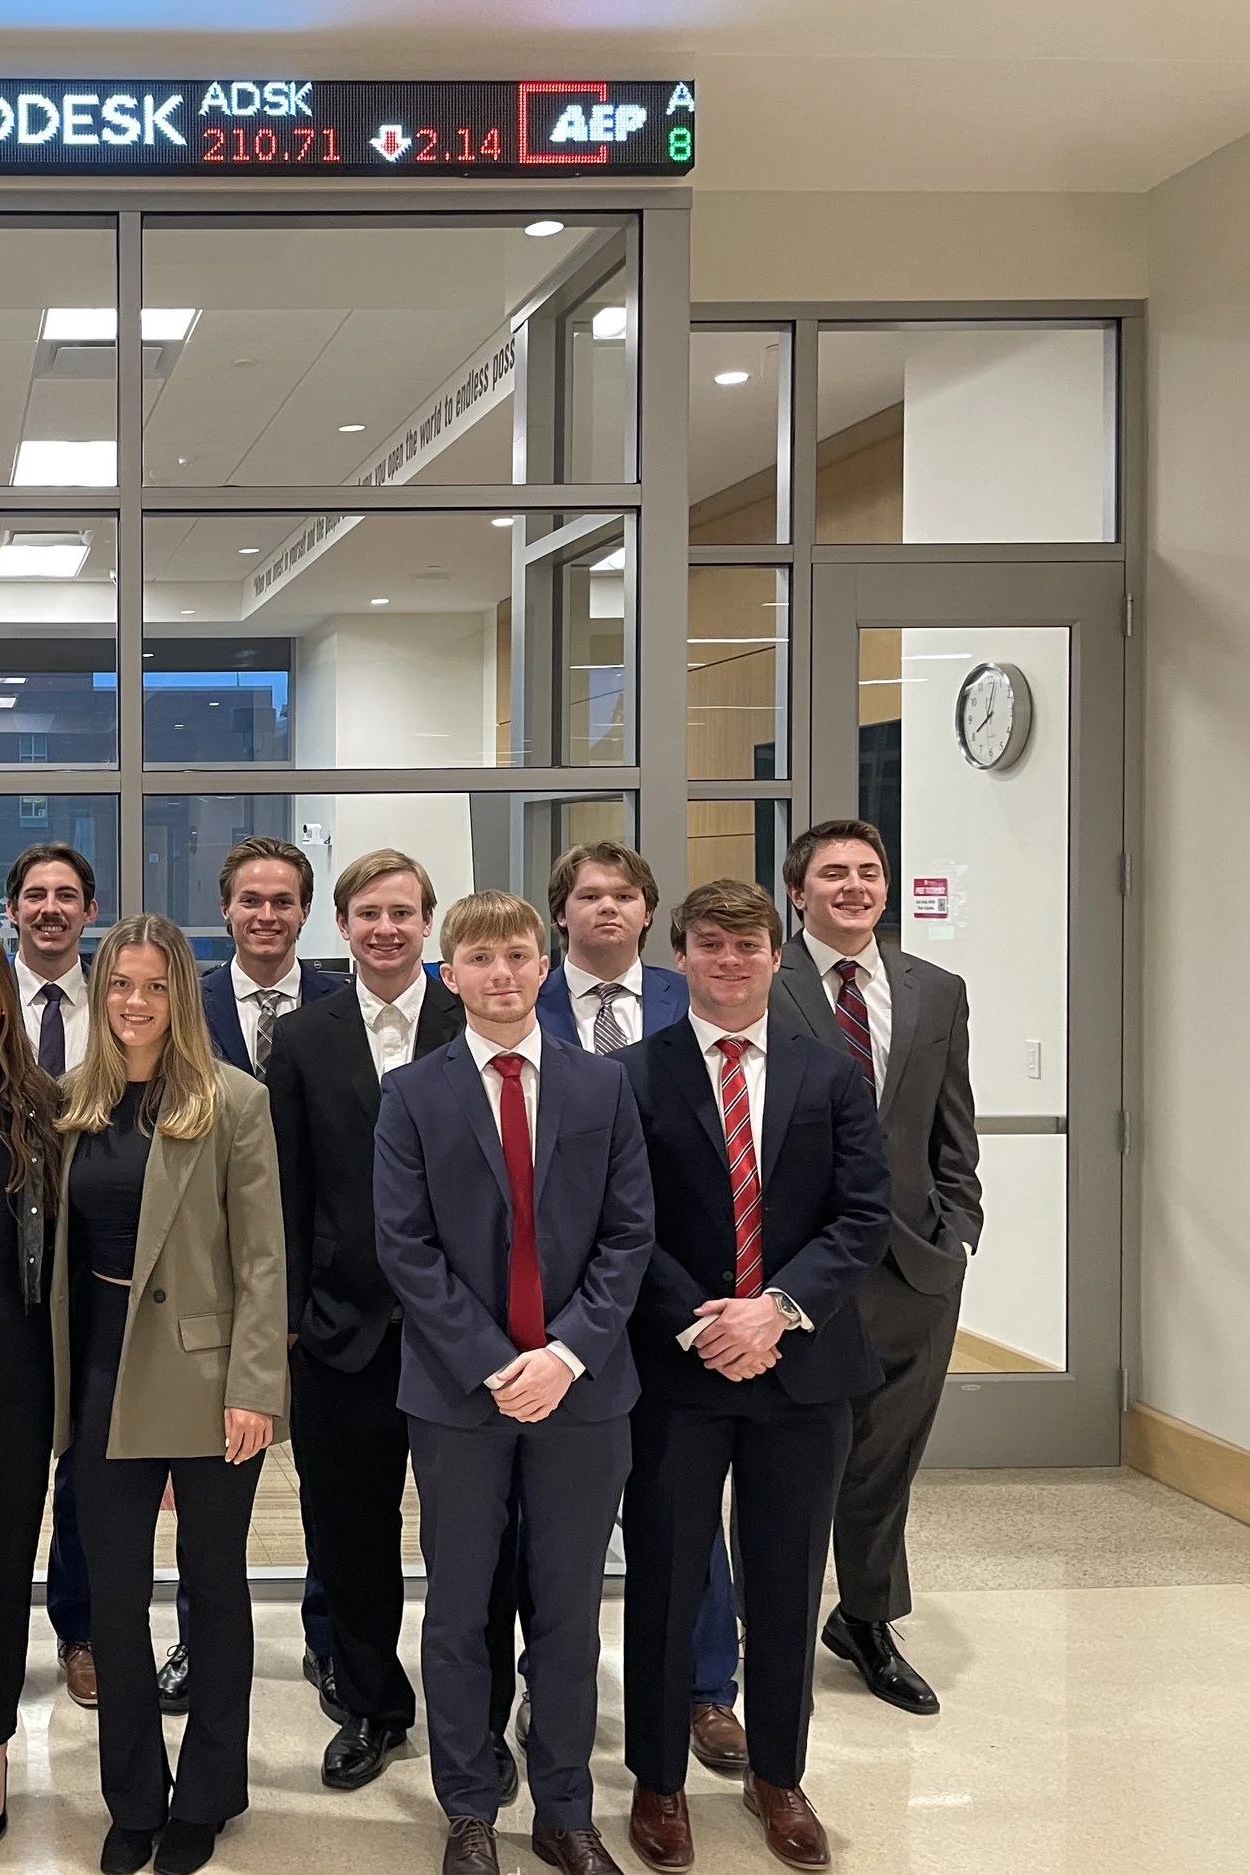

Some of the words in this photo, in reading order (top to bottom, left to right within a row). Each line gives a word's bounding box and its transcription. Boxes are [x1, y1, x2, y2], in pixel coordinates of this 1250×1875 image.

[199, 80, 313, 117] ADSK
[665, 81, 695, 115] A
[550, 104, 647, 142] AEP
[203, 127, 340, 162] 210.71
[415, 127, 501, 161] 2.14
[669, 127, 692, 161] 8
[405, 428, 418, 462] the
[419, 400, 443, 450] world
[444, 394, 453, 428] to
[455, 362, 489, 418] endless
